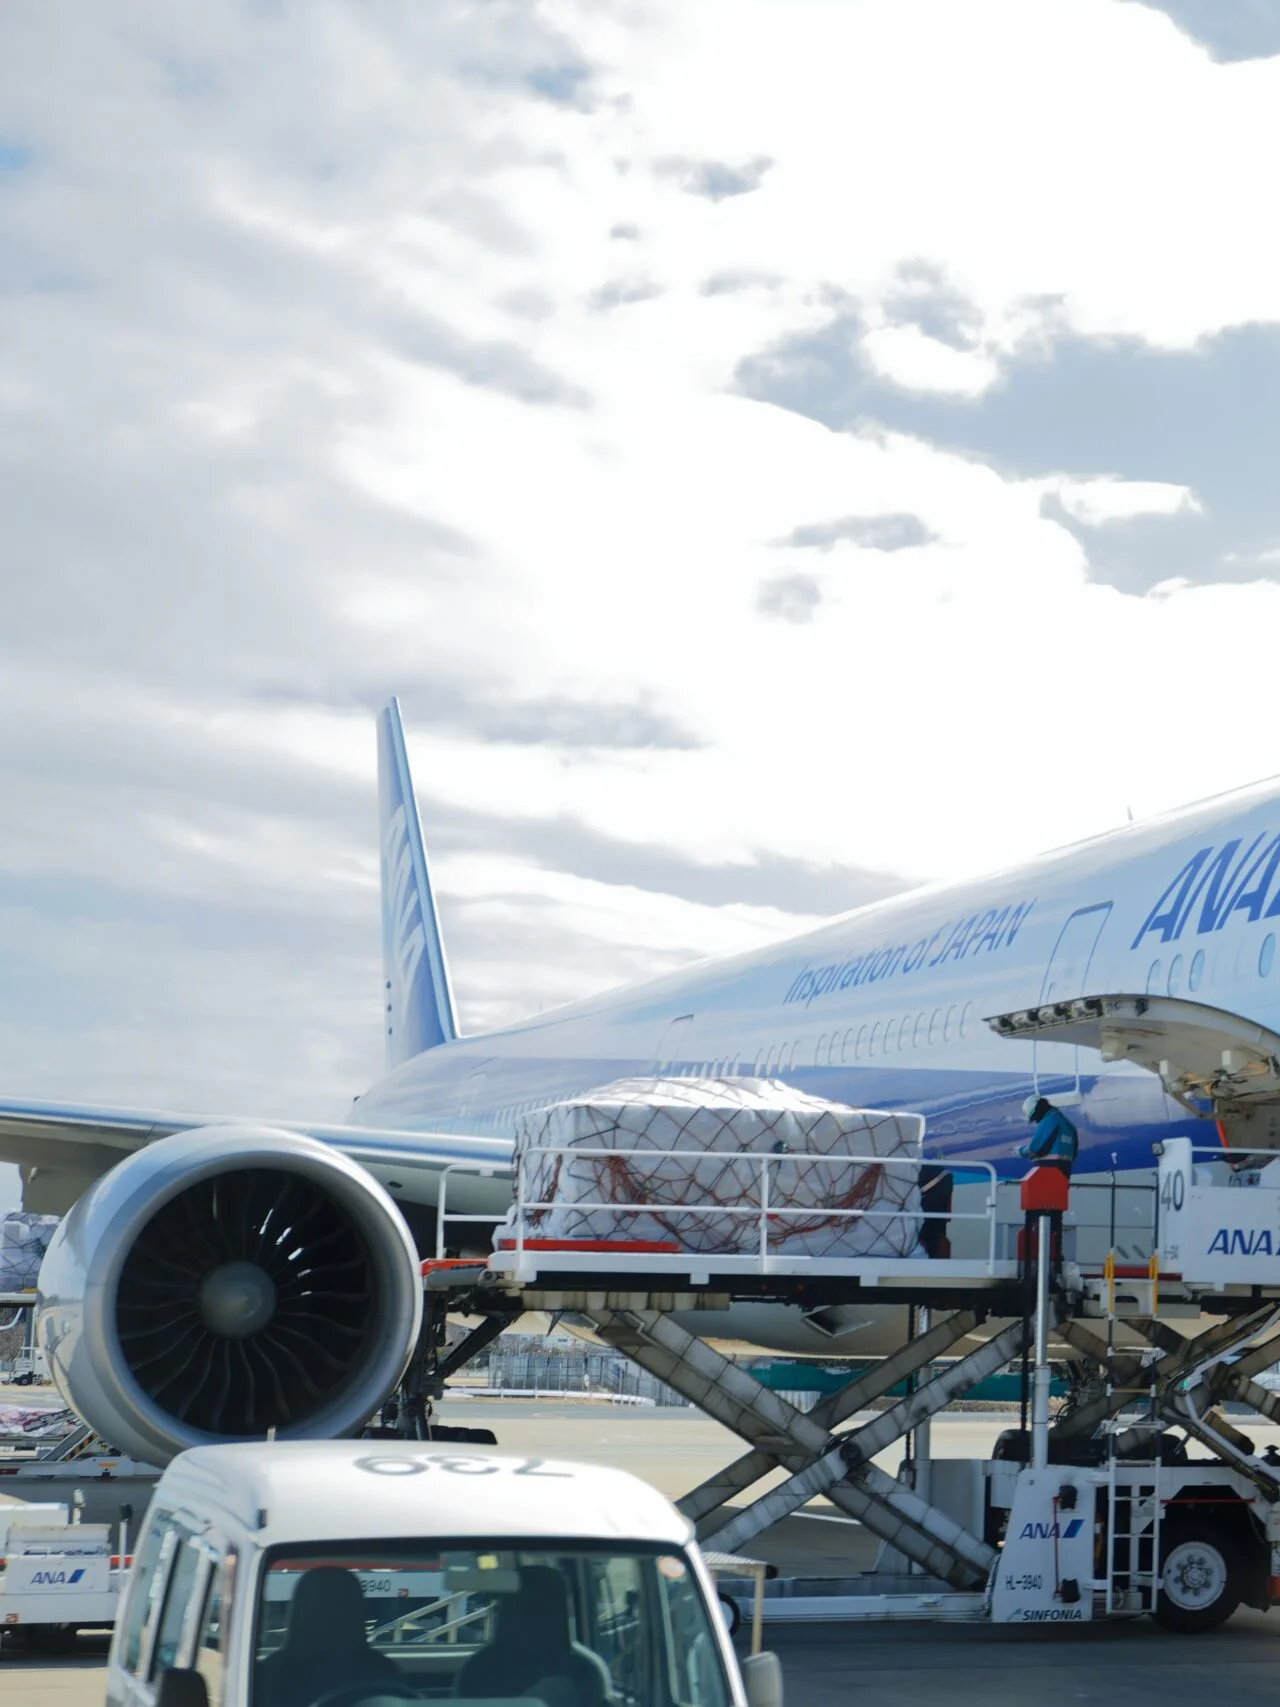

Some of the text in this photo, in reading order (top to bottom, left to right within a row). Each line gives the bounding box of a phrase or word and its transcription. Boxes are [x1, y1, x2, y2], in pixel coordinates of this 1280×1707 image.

[783, 897, 1038, 1009] Inspiration of JAPAN
[1161, 1168, 1185, 1212] 40
[1207, 1229, 1273, 1256] ANA
[1019, 1522, 1061, 1539] ANA
[30, 1571, 66, 1585] ANA
[1022, 1609, 1083, 1621] SINFONIA
